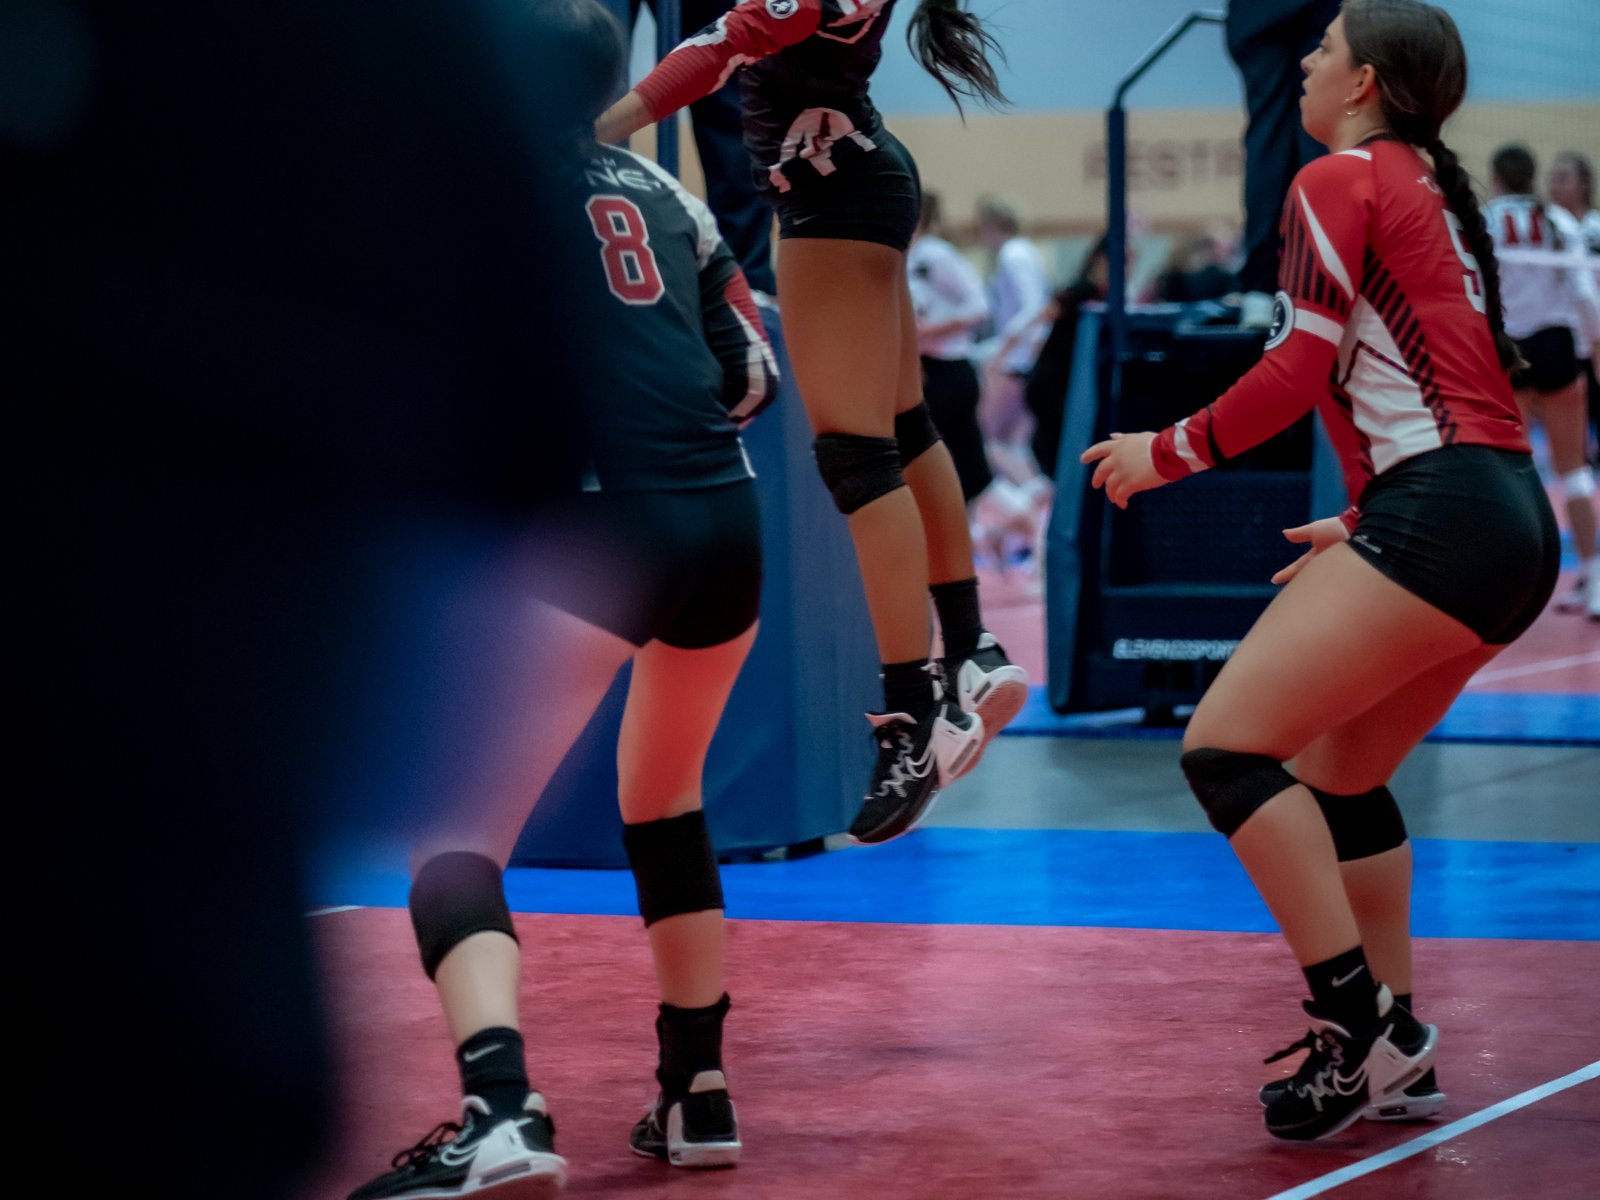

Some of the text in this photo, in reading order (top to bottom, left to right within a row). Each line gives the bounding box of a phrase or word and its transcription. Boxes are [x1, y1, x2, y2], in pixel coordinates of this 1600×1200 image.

[583, 167, 653, 192] NE
[584, 194, 665, 305] 8
[1442, 208, 1487, 315] 5
[1503, 208, 1544, 248] 11
